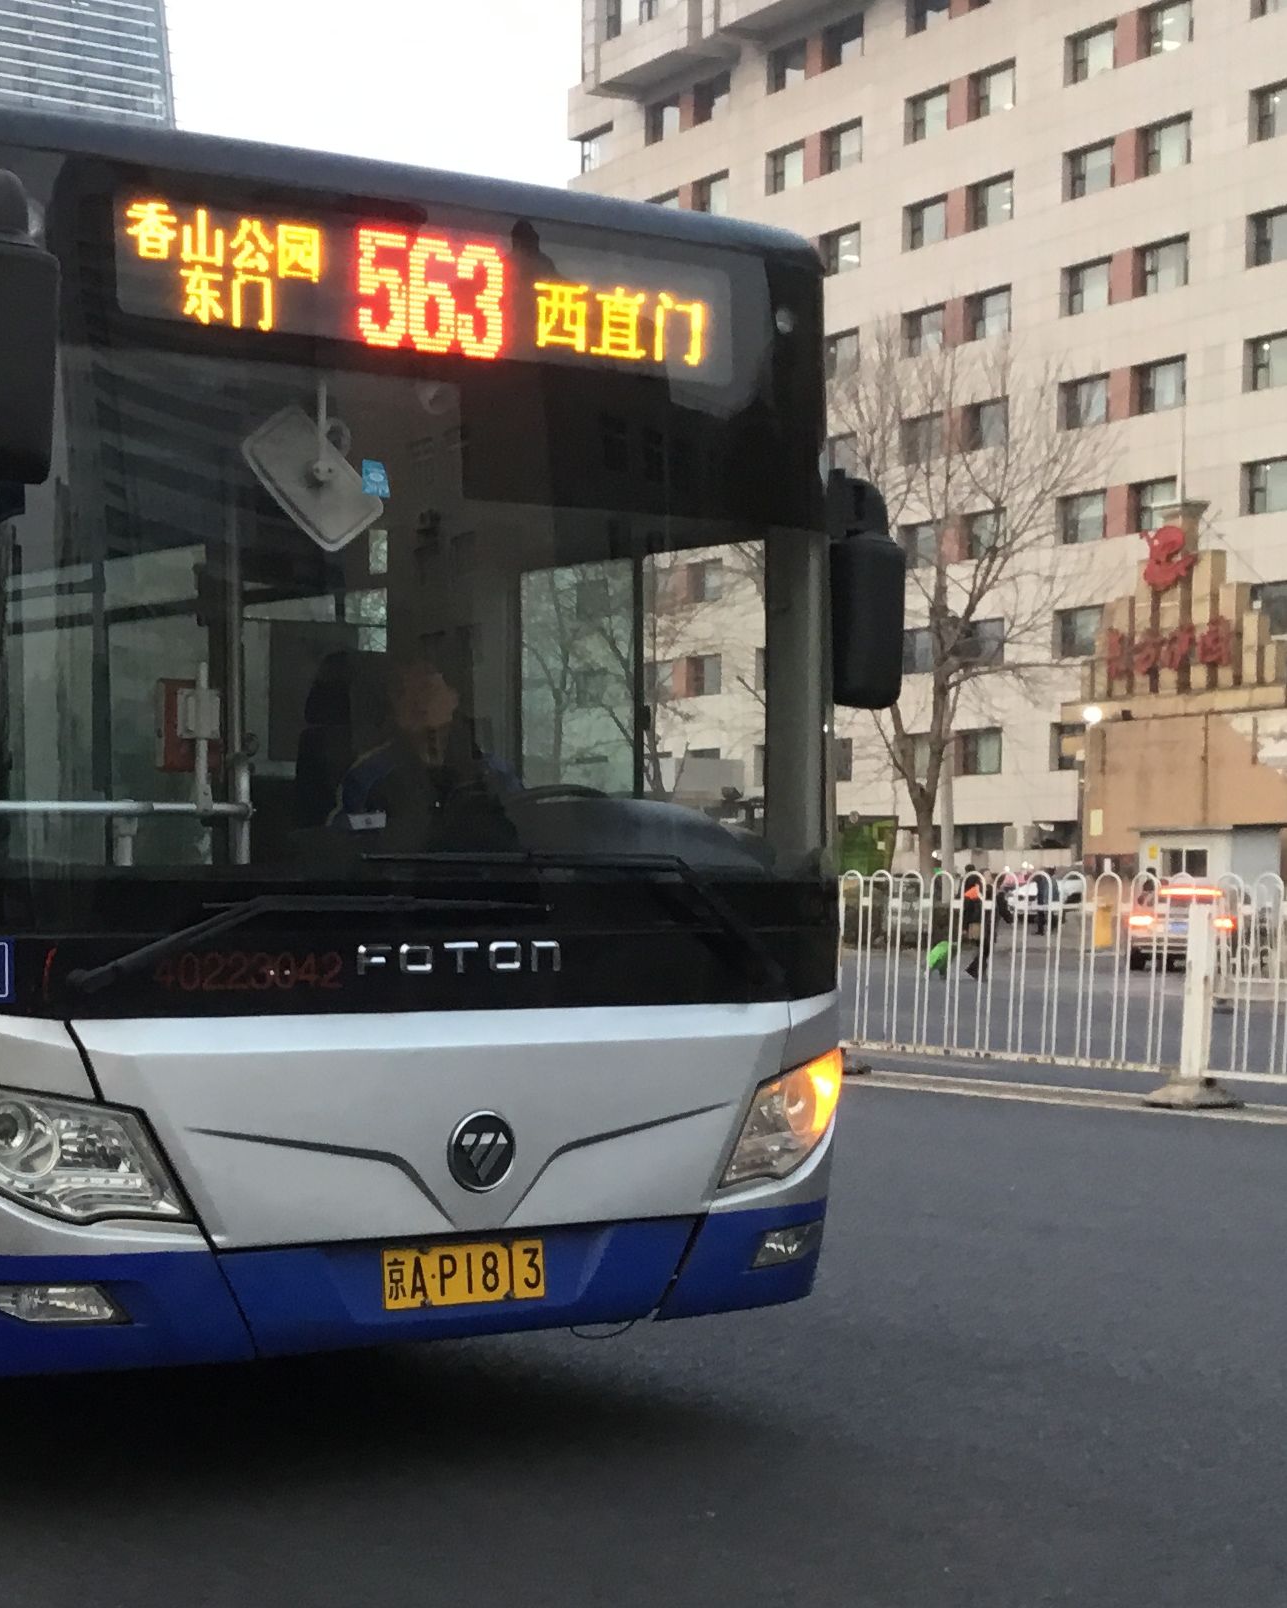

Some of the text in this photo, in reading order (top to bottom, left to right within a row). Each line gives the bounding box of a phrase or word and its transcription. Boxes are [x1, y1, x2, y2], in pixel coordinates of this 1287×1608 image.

[126, 201, 321, 283] 香山公园
[179, 267, 274, 332] 东门
[358, 228, 505, 360] 563
[534, 281, 705, 368] 西直门
[154, 951, 344, 992] 40223042
[356, 940, 562, 975] FOTON
